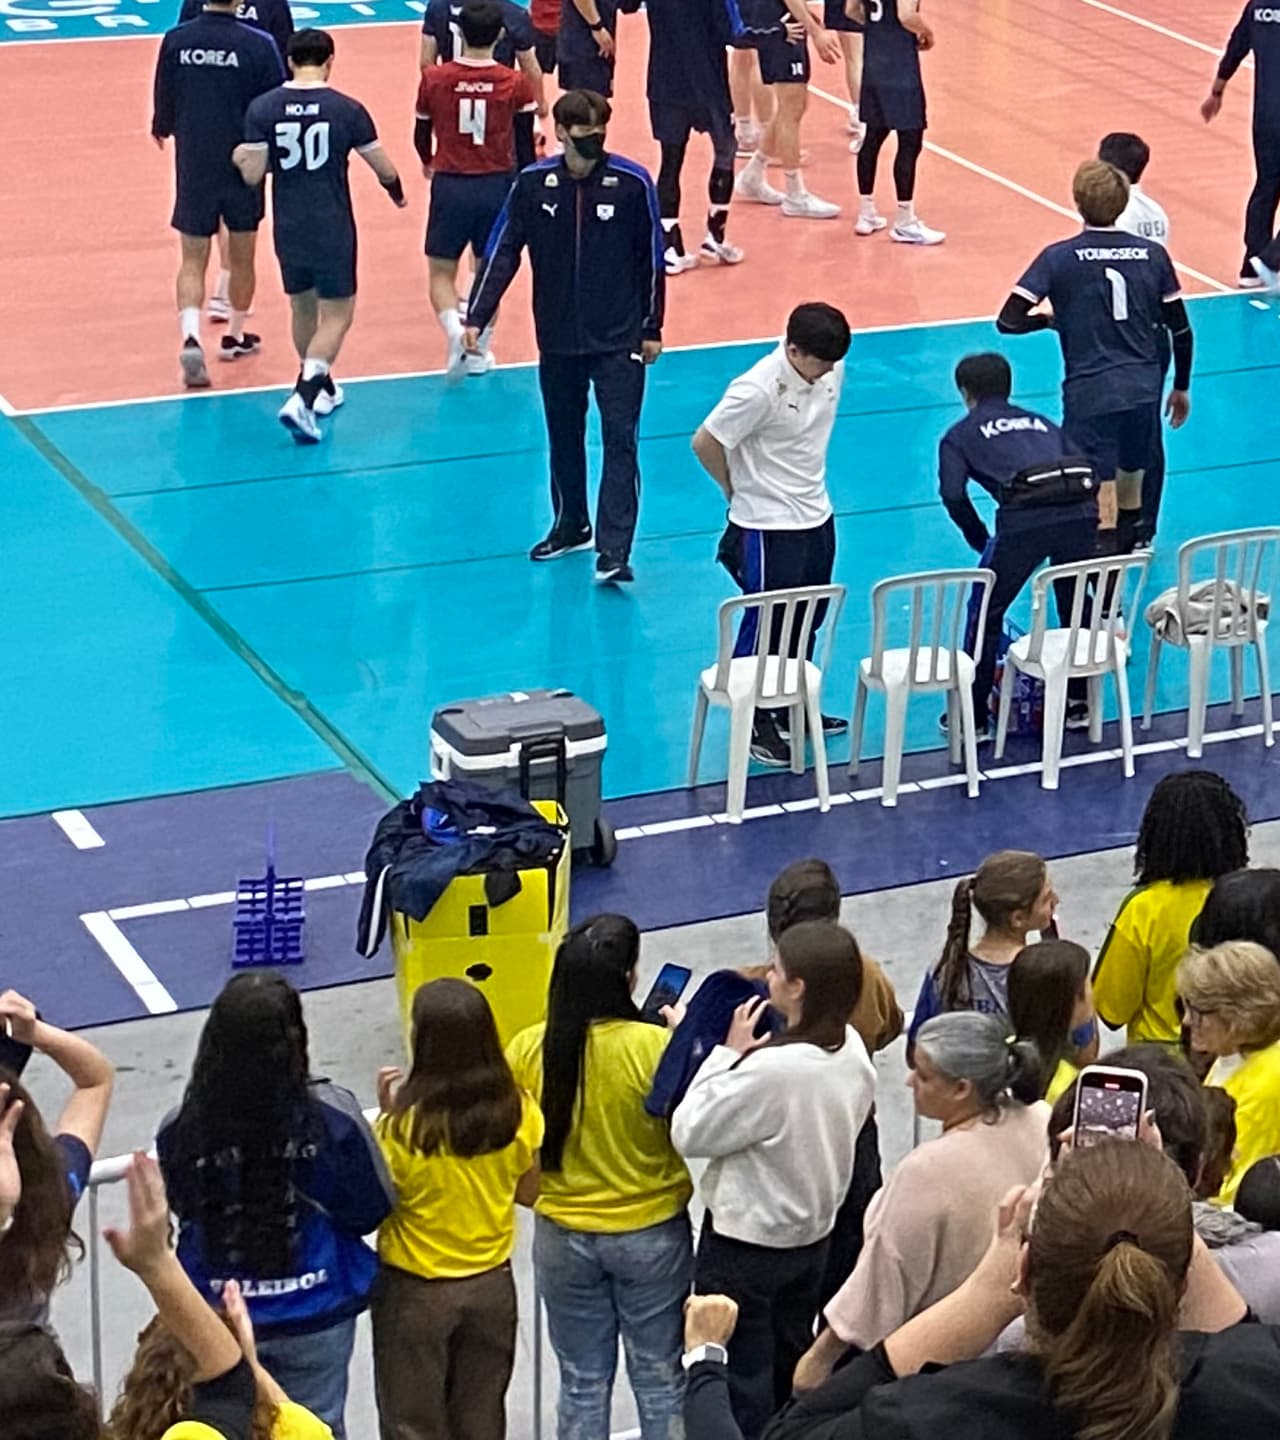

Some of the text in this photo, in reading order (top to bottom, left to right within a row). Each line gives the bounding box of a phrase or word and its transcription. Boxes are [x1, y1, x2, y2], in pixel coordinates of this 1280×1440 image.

[180, 49, 239, 68] KOREA
[459, 98, 487, 146] 4
[275, 122, 330, 171] 30
[1074, 247, 1150, 261] YOUNGSEOK
[1104, 267, 1129, 321] 1
[210, 1268, 329, 1298] VLEIBOL
